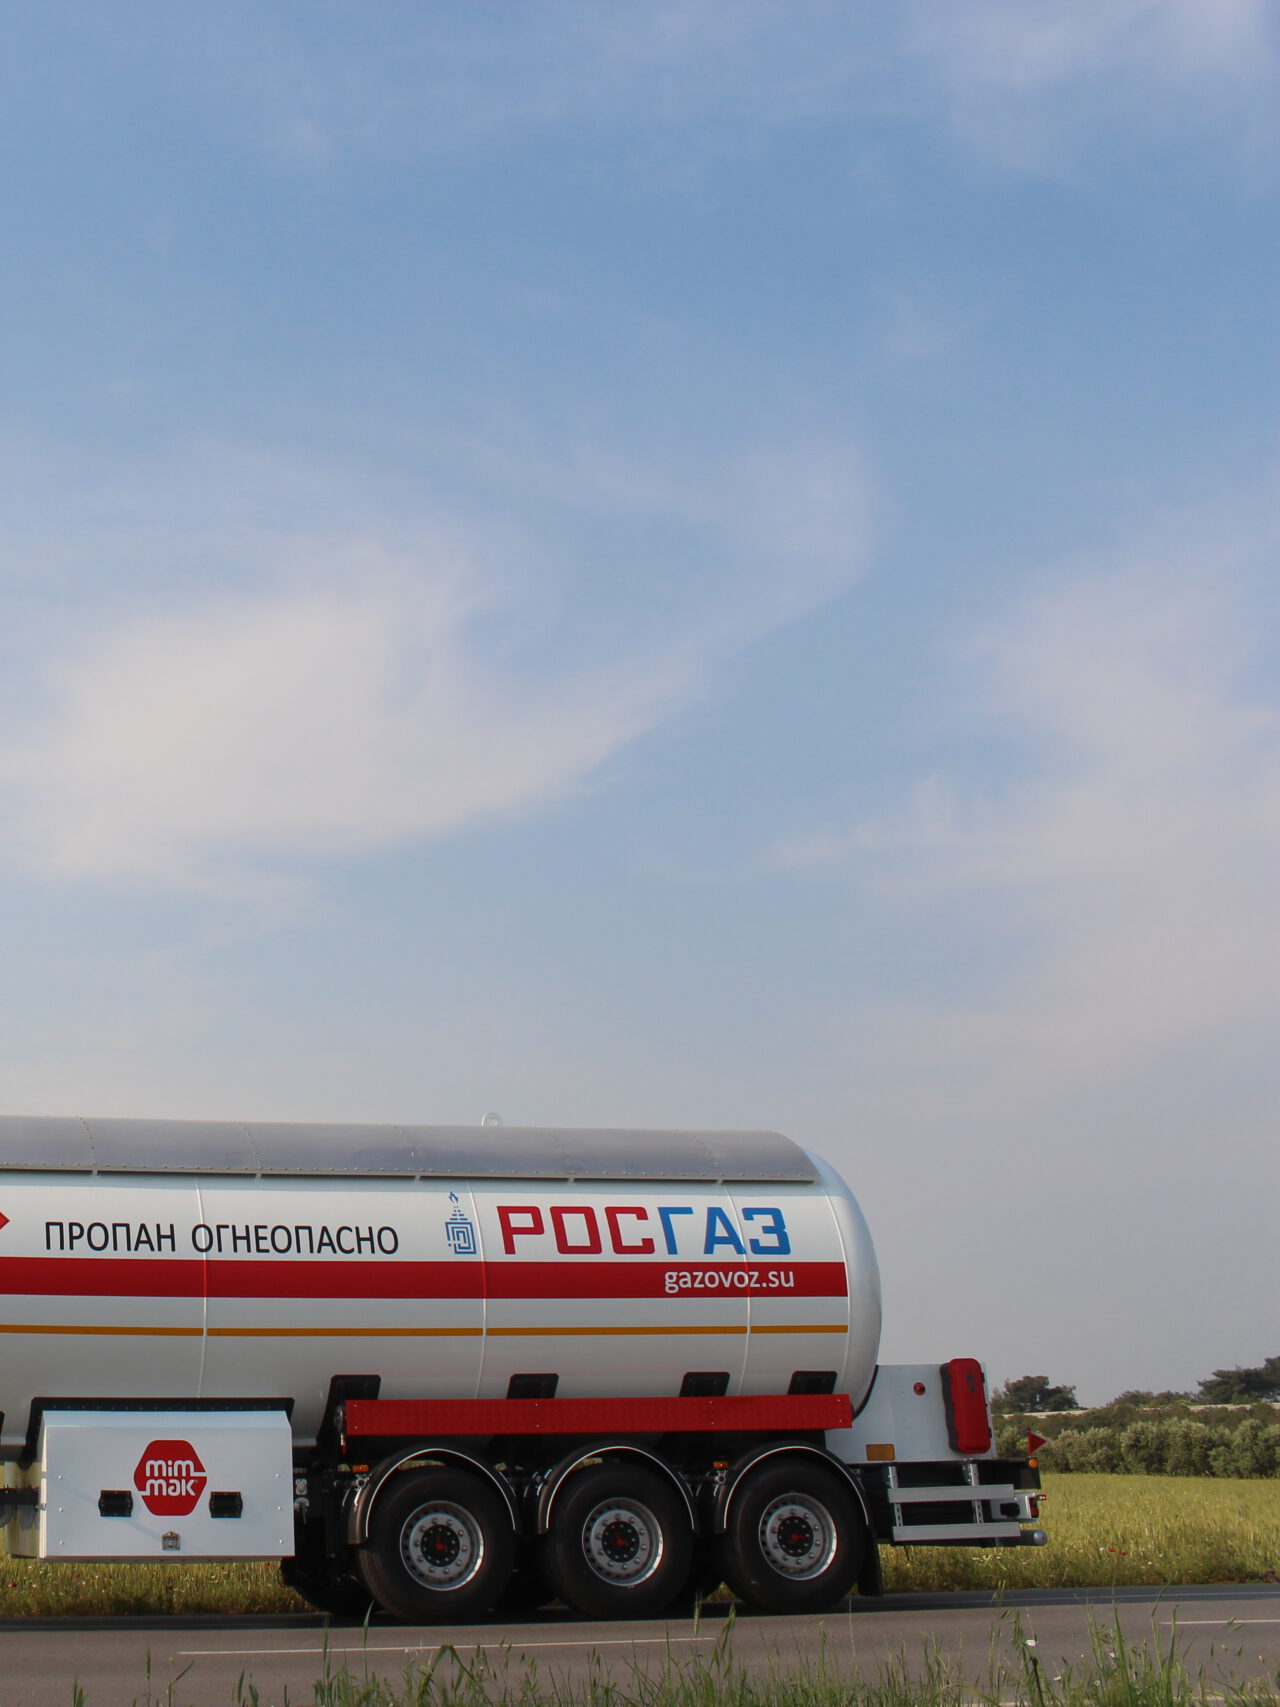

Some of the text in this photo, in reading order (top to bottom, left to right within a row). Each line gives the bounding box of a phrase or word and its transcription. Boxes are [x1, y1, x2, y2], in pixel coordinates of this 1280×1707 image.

[45, 1221, 399, 1254] ПРОПАН ОГНЕОПАСНО
[496, 1206, 791, 1255] РОСГАЗ
[664, 1270, 795, 1293] gazovoz.su
[146, 1460, 194, 1477] mim
[146, 1479, 195, 1496] mak
